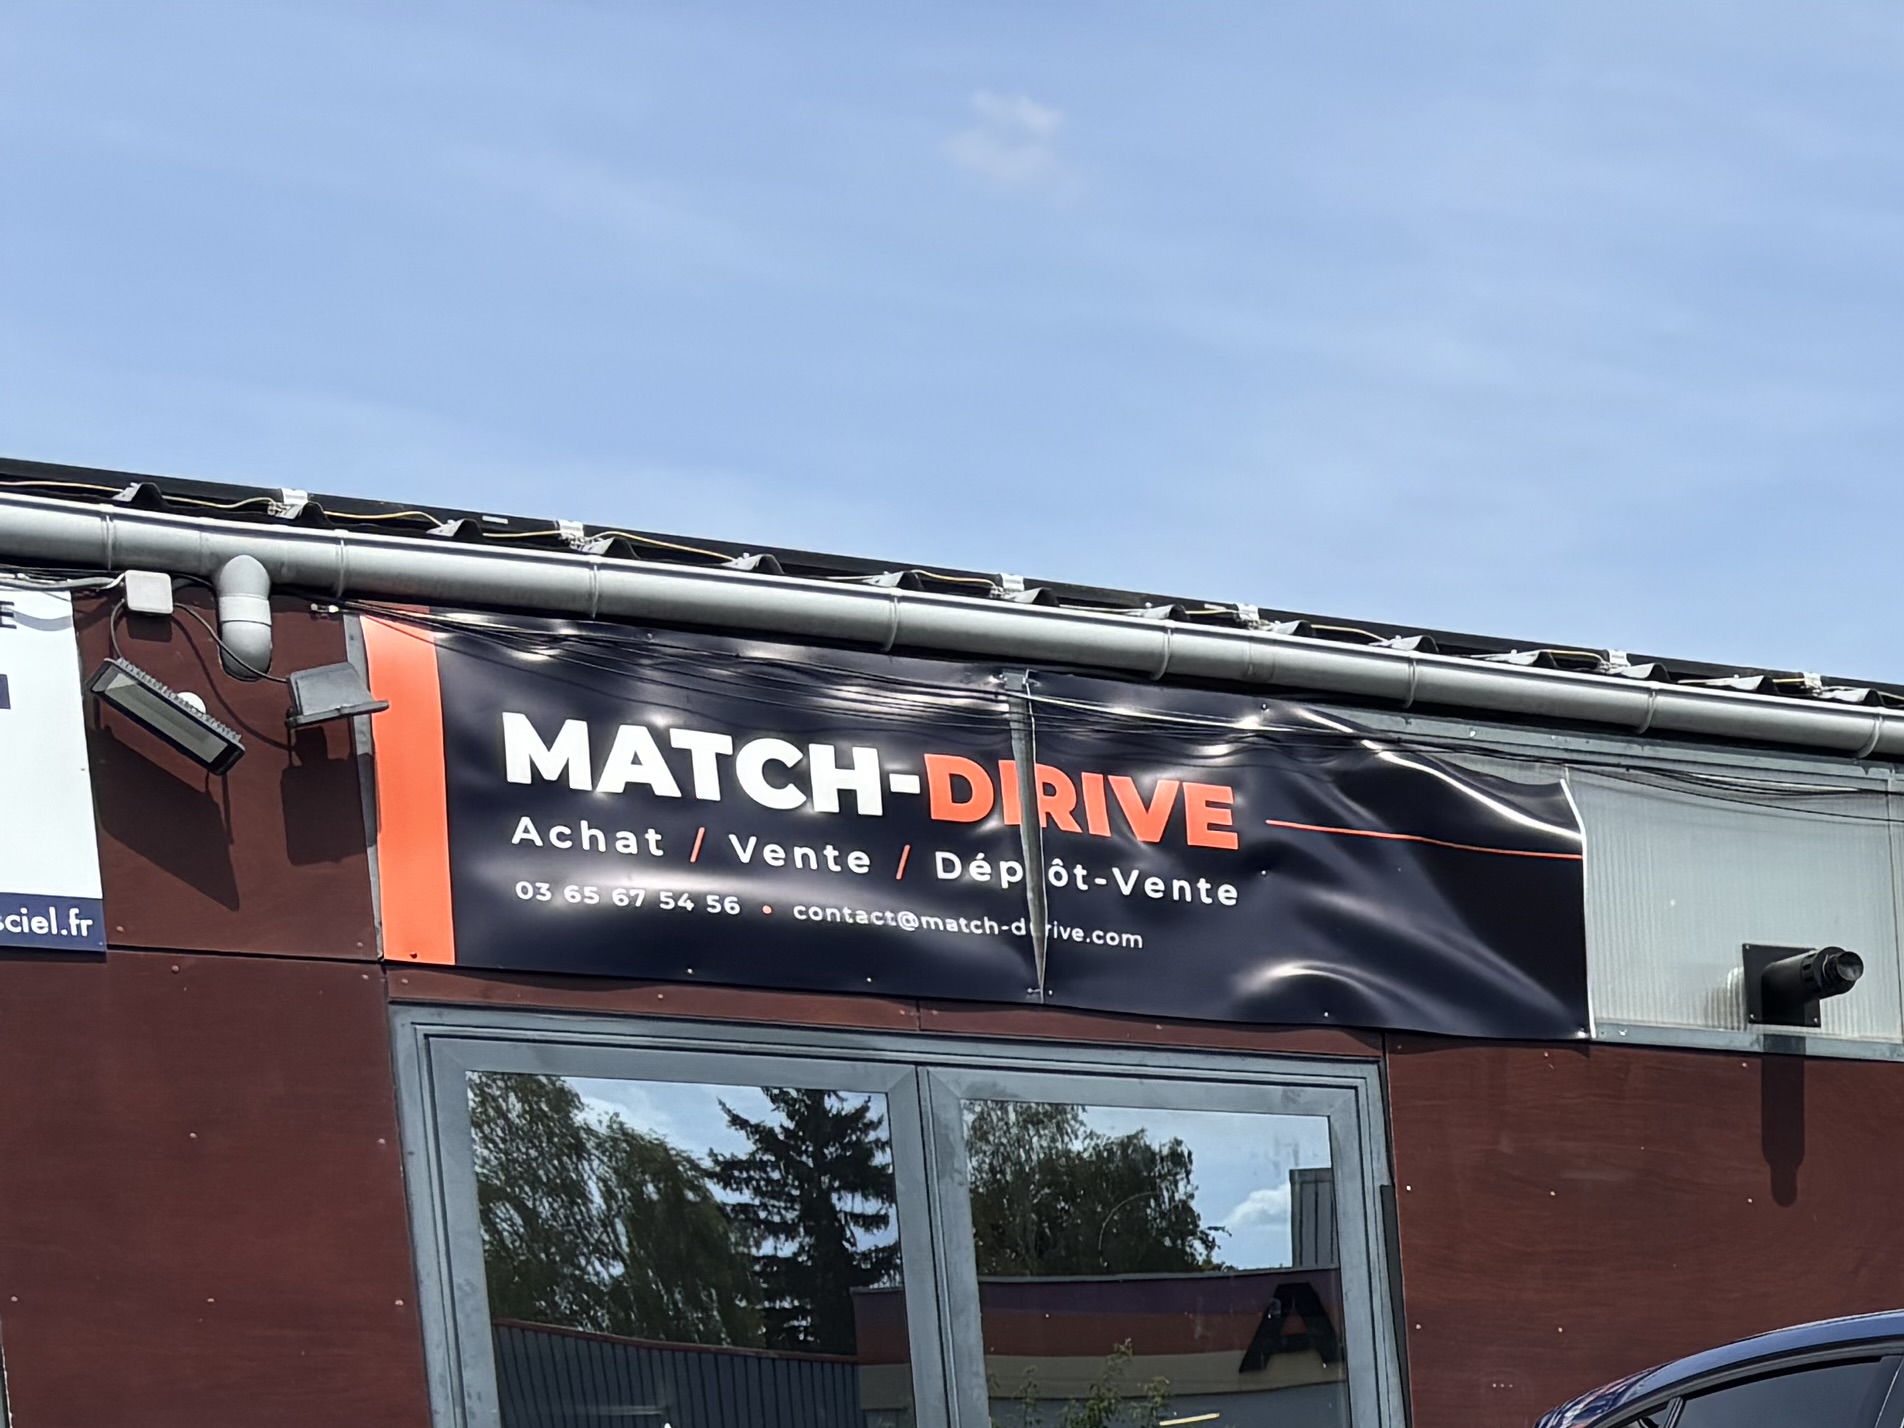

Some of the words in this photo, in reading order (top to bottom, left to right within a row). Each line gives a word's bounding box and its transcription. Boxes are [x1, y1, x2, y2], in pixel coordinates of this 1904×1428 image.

[502, 711, 1239, 850] MATCH-DRIVE
[511, 815, 664, 857] Achat
[728, 833, 872, 874] Vente
[935, 850, 1239, 906] Dépôt-Vente
[515, 880, 552, 902] 03
[563, 884, 601, 905] 65
[611, 887, 646, 908] 67
[658, 891, 695, 912] 54
[706, 894, 741, 915] 56
